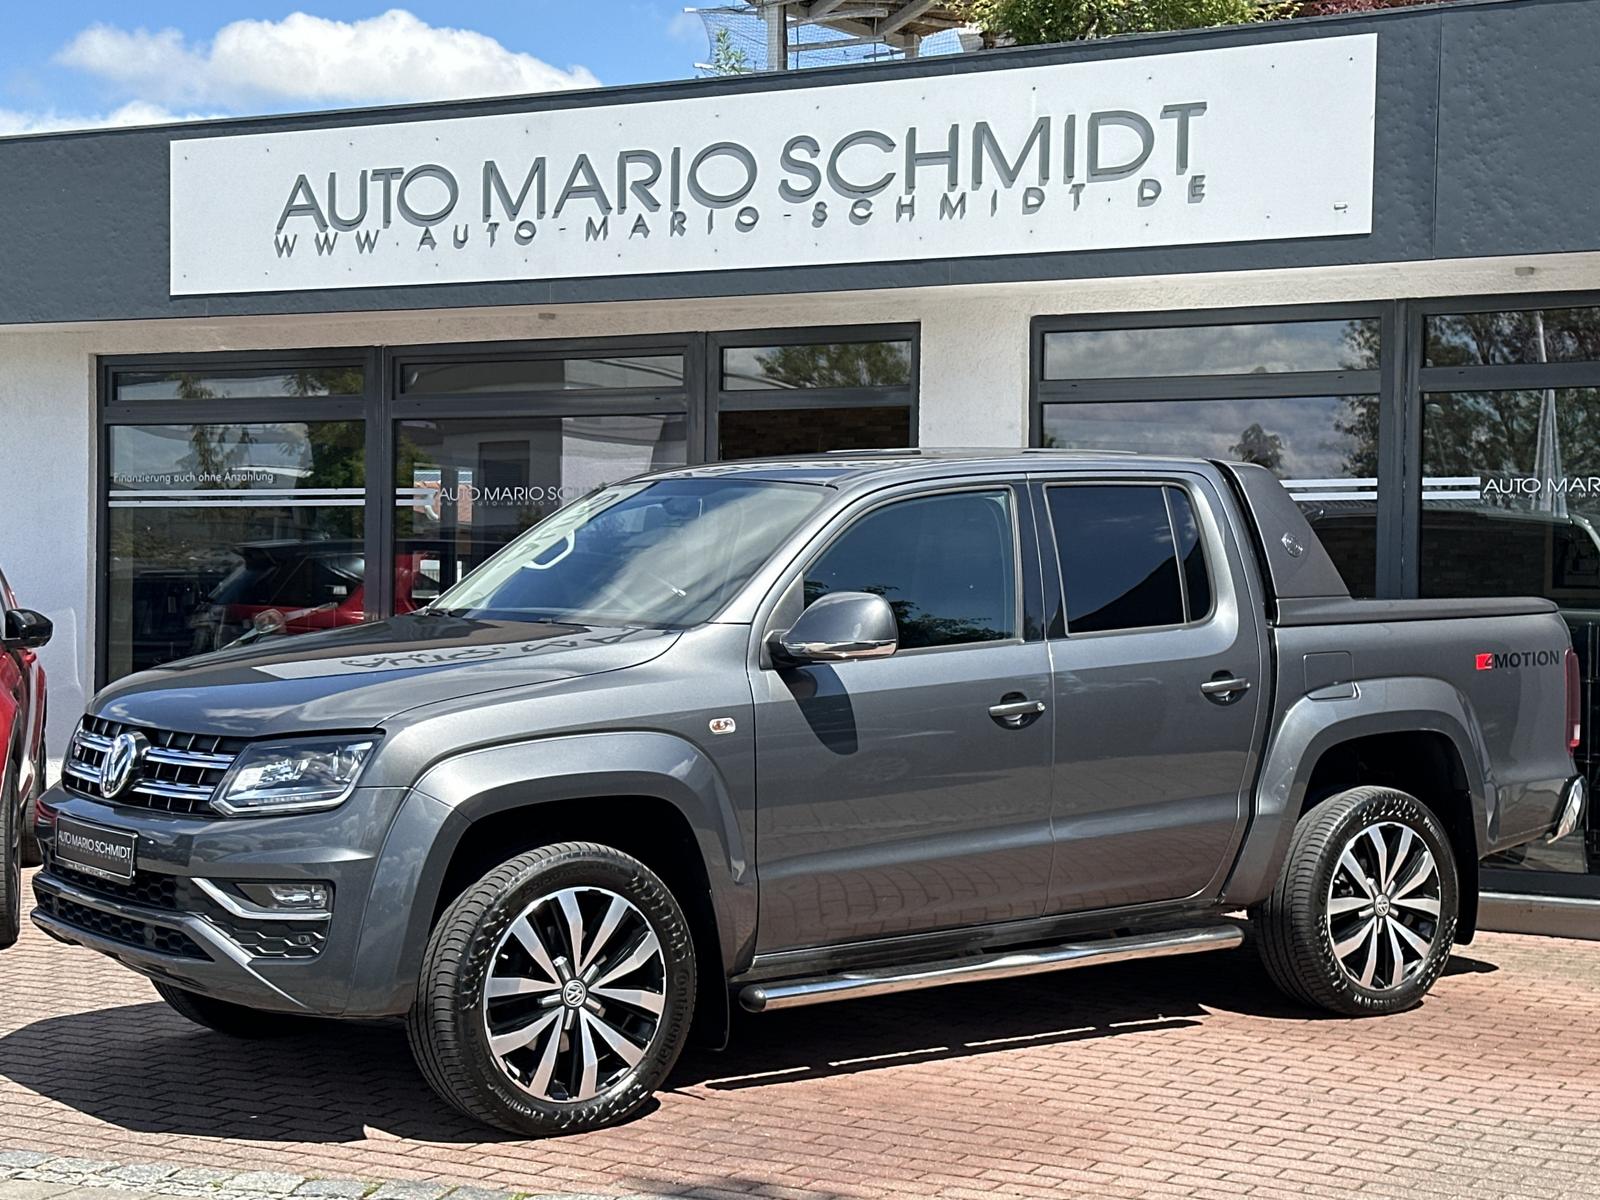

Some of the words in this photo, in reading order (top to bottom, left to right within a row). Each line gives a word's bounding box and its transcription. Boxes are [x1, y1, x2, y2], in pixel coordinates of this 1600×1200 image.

[275, 164, 459, 235] AUTO
[482, 141, 758, 222] MARIO
[778, 102, 1207, 203] SCHMIDT
[113, 471, 171, 485] Finanzierung
[173, 471, 196, 483] auch
[199, 471, 222, 483] ohne
[224, 471, 274, 485] Anzahlung
[1483, 478, 1541, 494] AUTO
[439, 486, 481, 501] AUTO
[484, 486, 544, 501] MARIO
[58, 829, 72, 845] AUTO
[71, 833, 95, 851] MARIO
[94, 840, 131, 860] SCHMIDT
